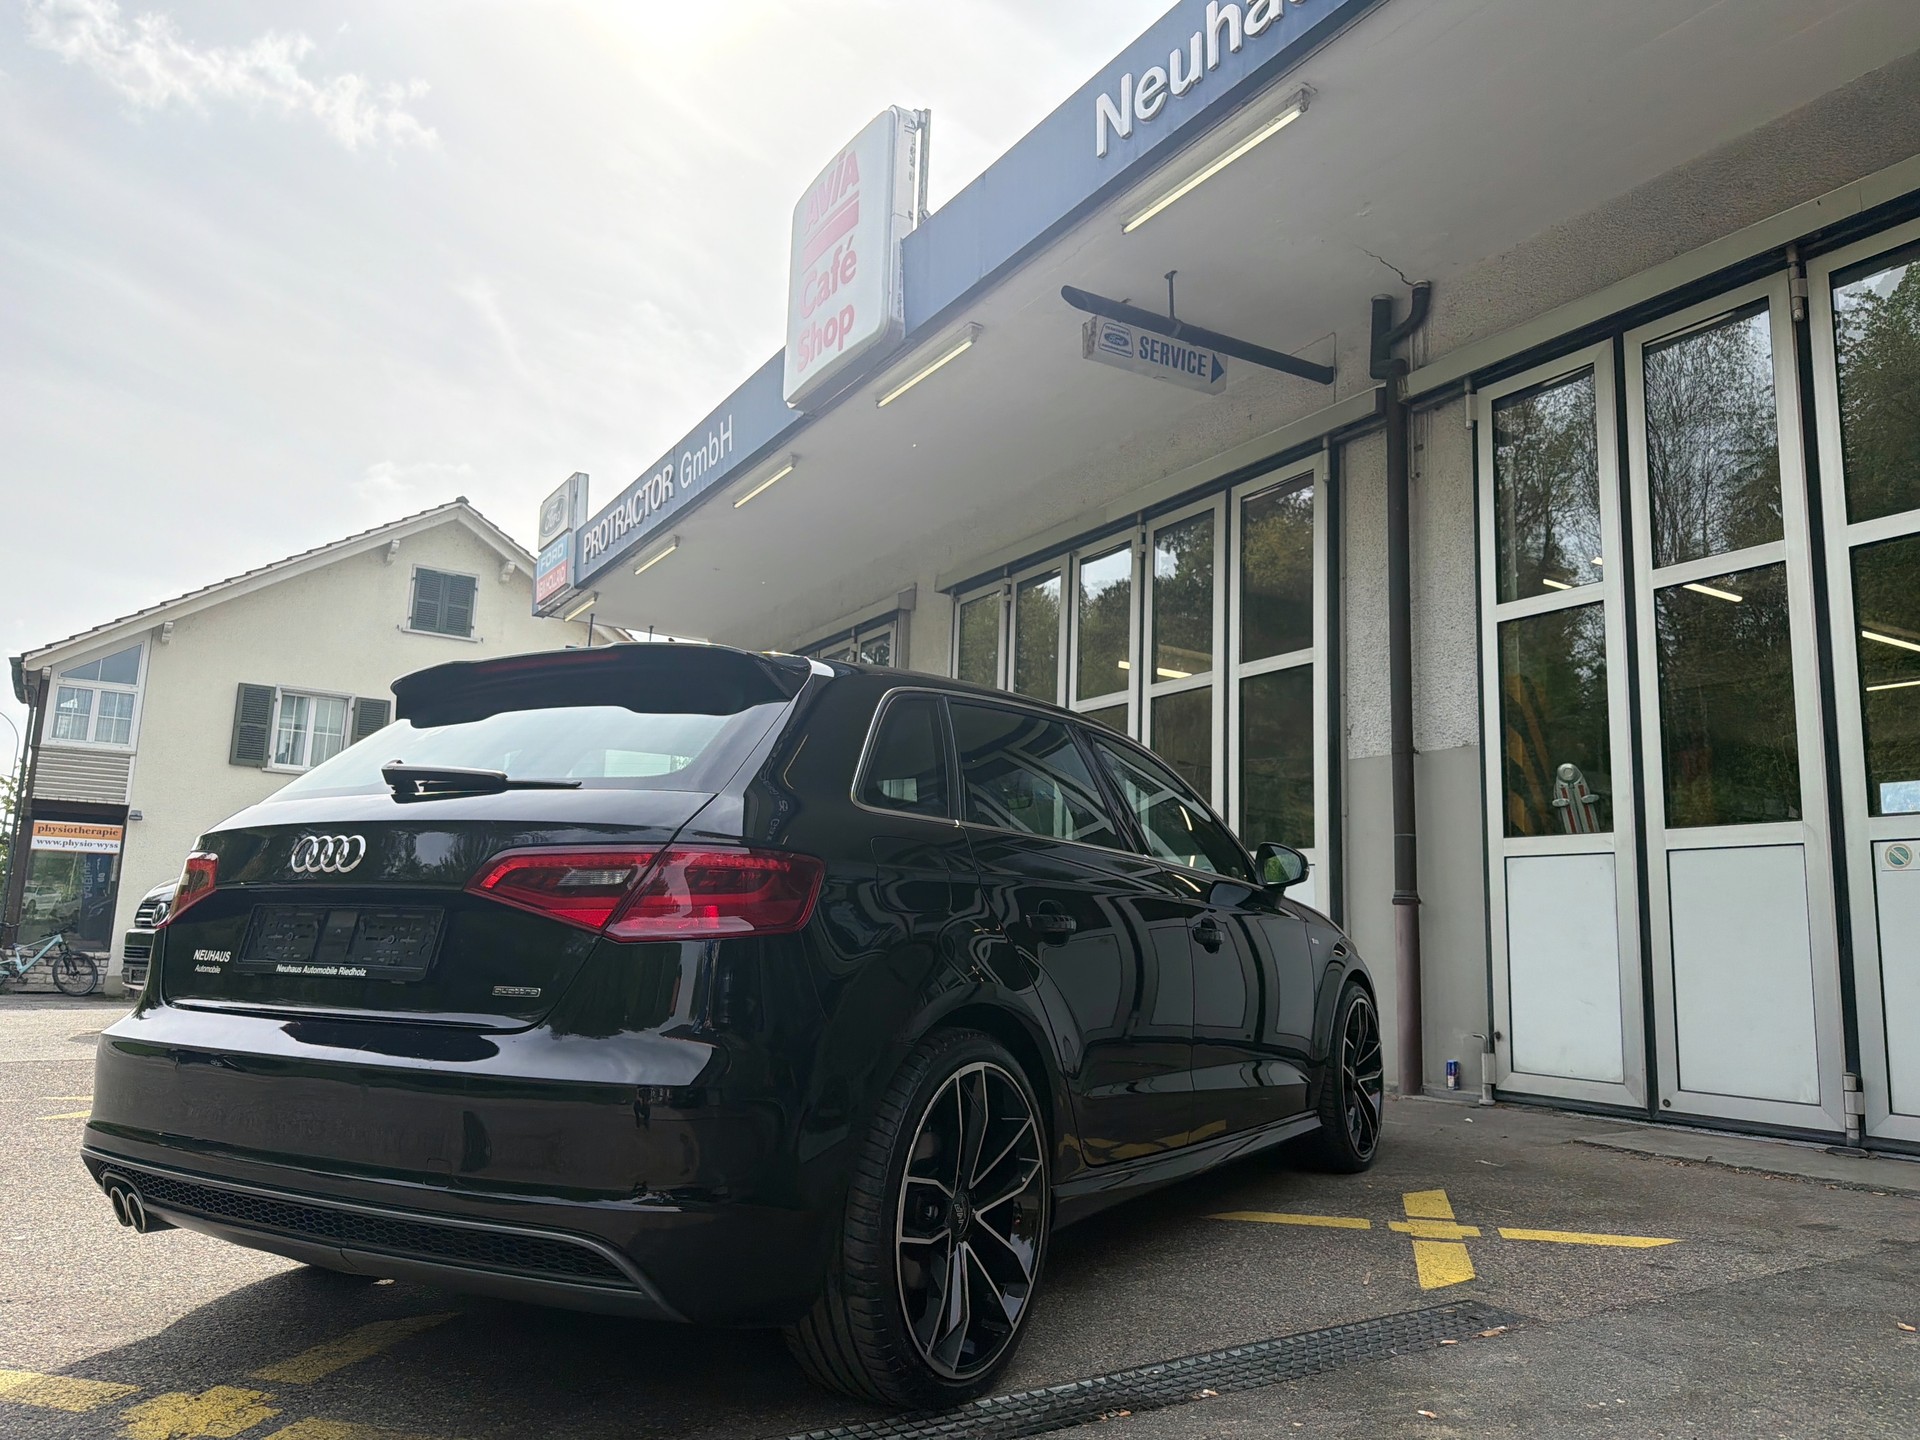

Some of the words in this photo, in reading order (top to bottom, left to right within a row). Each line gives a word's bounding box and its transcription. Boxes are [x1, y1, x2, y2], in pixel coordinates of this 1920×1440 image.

[1096, 0, 1301, 159] Neuha
[802, 235, 857, 320] Café
[798, 303, 855, 373] Shop
[1139, 336, 1207, 377] SERVICE
[583, 463, 675, 565] PROTRACTOR
[679, 414, 733, 489] GmbH
[540, 543, 564, 572] FORD
[36, 839, 119, 850] www.physio-wyss
[37, 824, 119, 838] physiotherapie
[193, 949, 232, 963] NEUHAUS
[194, 964, 222, 974] Automobile
[275, 964, 303, 973] Neuhaus
[302, 965, 338, 975] Automobile
[338, 966, 367, 977] Riedholz
